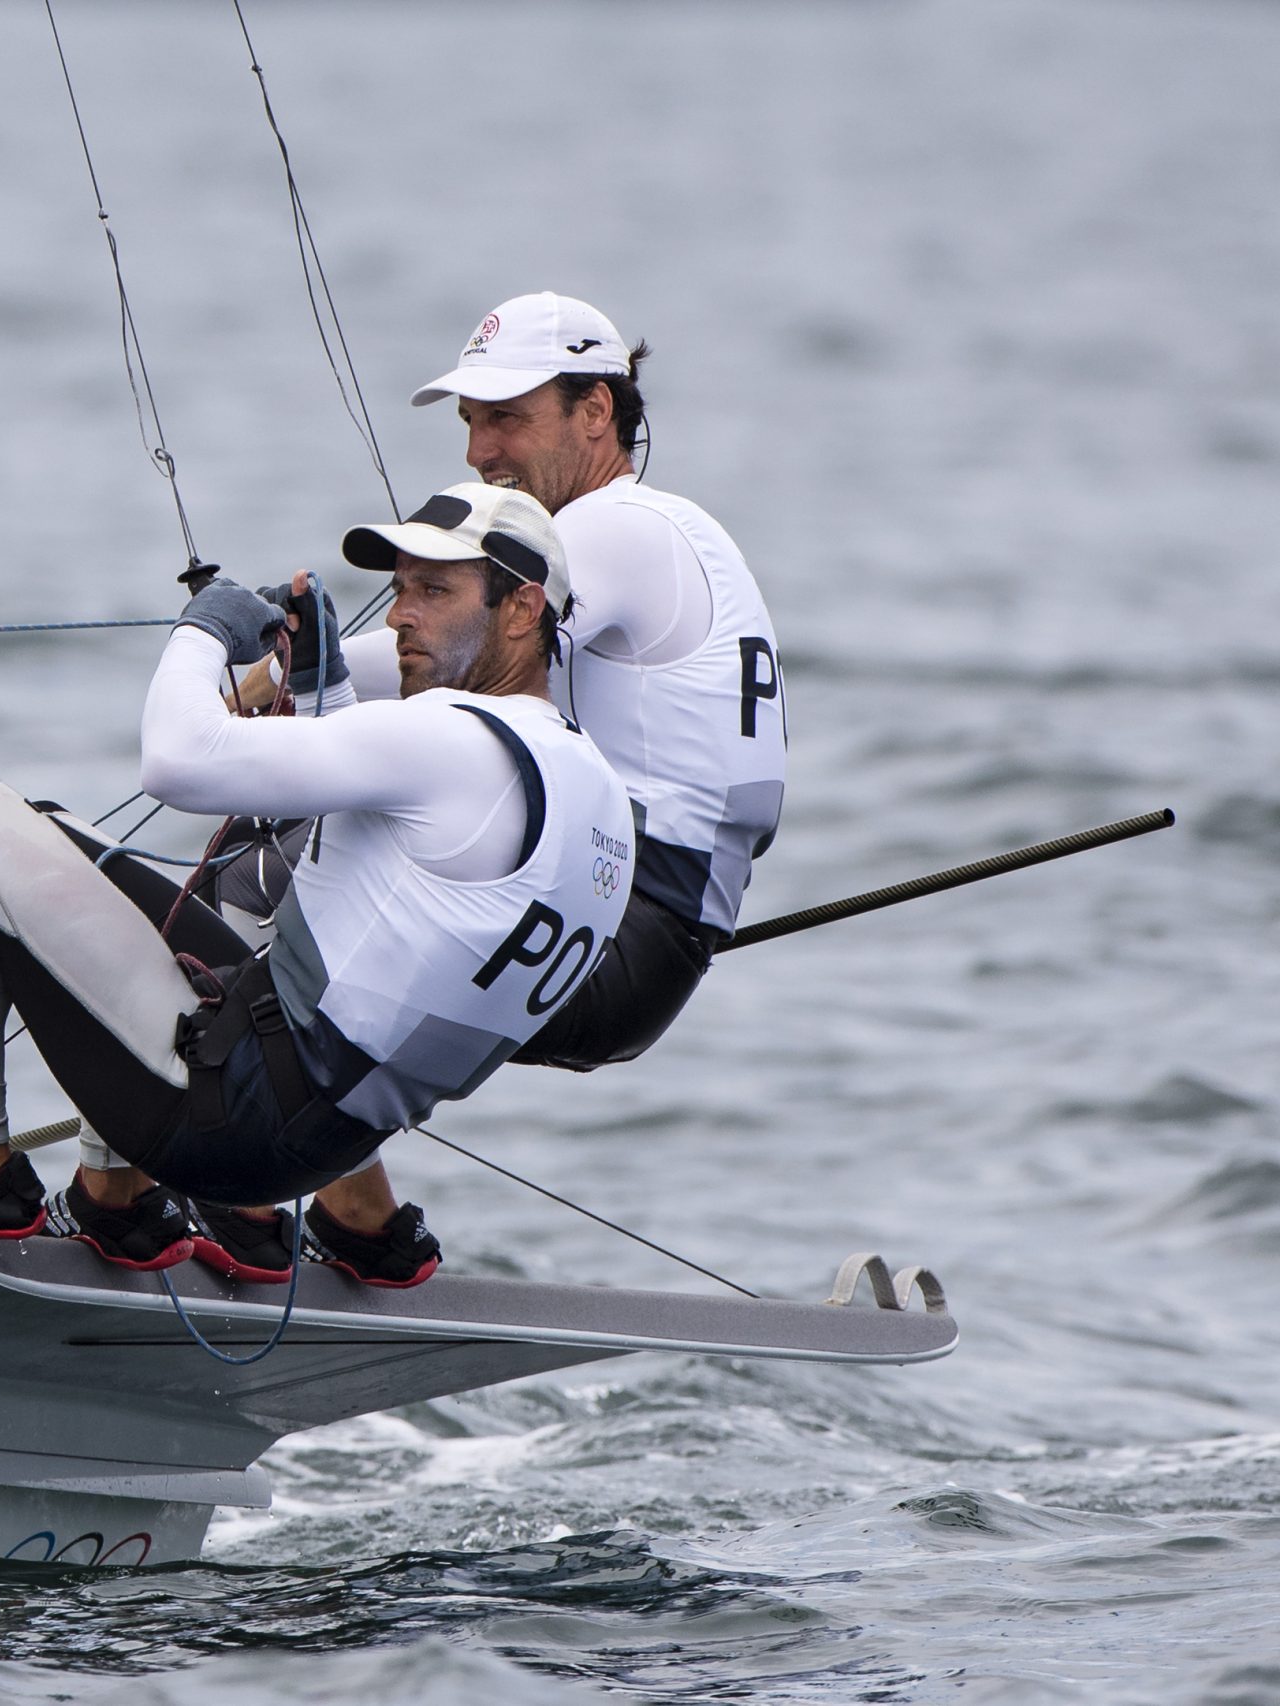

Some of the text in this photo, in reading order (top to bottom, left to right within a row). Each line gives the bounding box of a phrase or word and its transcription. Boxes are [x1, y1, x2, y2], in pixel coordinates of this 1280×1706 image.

[739, 637, 788, 752] P
[591, 826, 628, 861] TOKYO 2020
[471, 899, 616, 1016] PO
